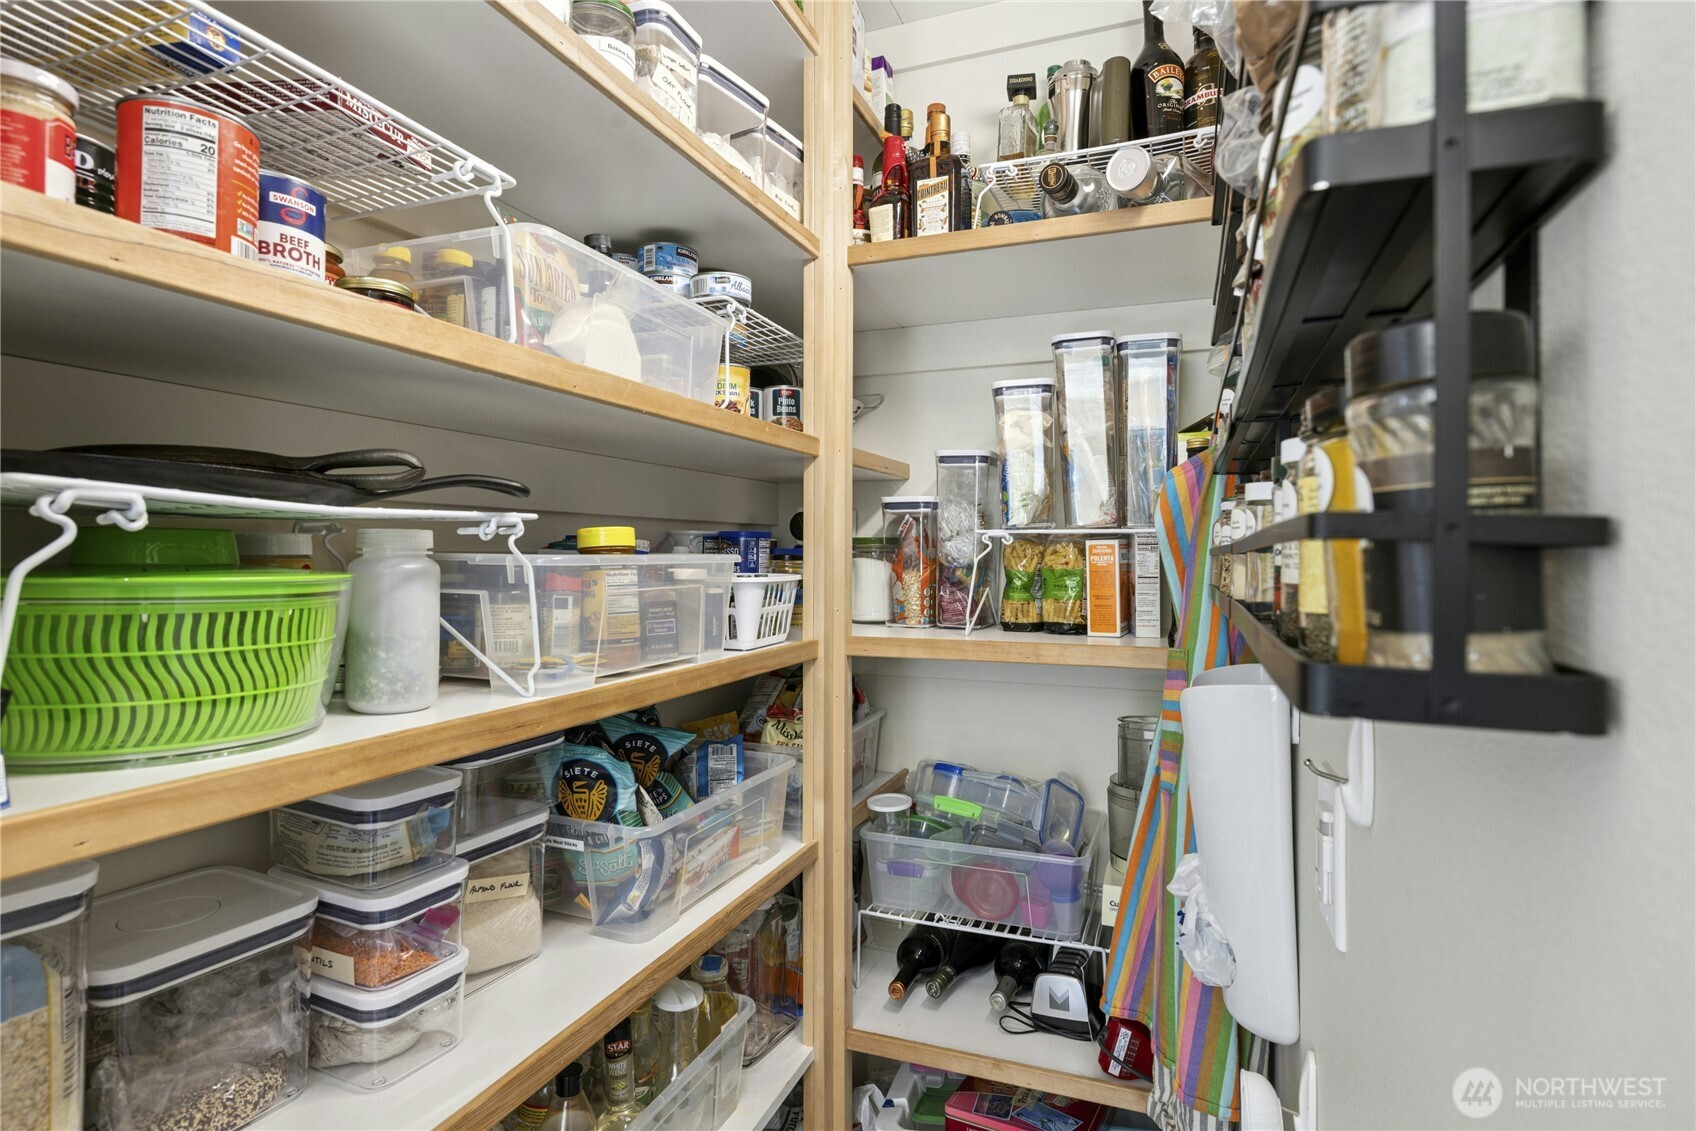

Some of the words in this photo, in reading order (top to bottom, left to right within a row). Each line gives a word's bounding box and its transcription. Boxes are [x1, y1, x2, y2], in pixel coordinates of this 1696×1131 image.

[661, 76, 676, 90] OAT
[1185, 88, 1224, 107] RAMBUE
[144, 107, 187, 121] Nutrition
[189, 114, 217, 129] Facts
[144, 136, 183, 148] Calories
[200, 144, 216, 156] 20
[273, 194, 315, 214] SWANSON
[280, 233, 310, 250] BEEF
[258, 240, 321, 271] BROTH
[776, 405, 797, 413] Beans
[778, 397, 795, 406] Pinto
[771, 719, 794, 741] Miss
[625, 740, 657, 753] SIETE
[564, 767, 599, 779] SIETE
[600, 852, 634, 876] Salt
[469, 884, 496, 895] ALMOND
[500, 880, 523, 891] FLOUR
[607, 1041, 630, 1052] STAR
[608, 1060, 628, 1070] WHITE
